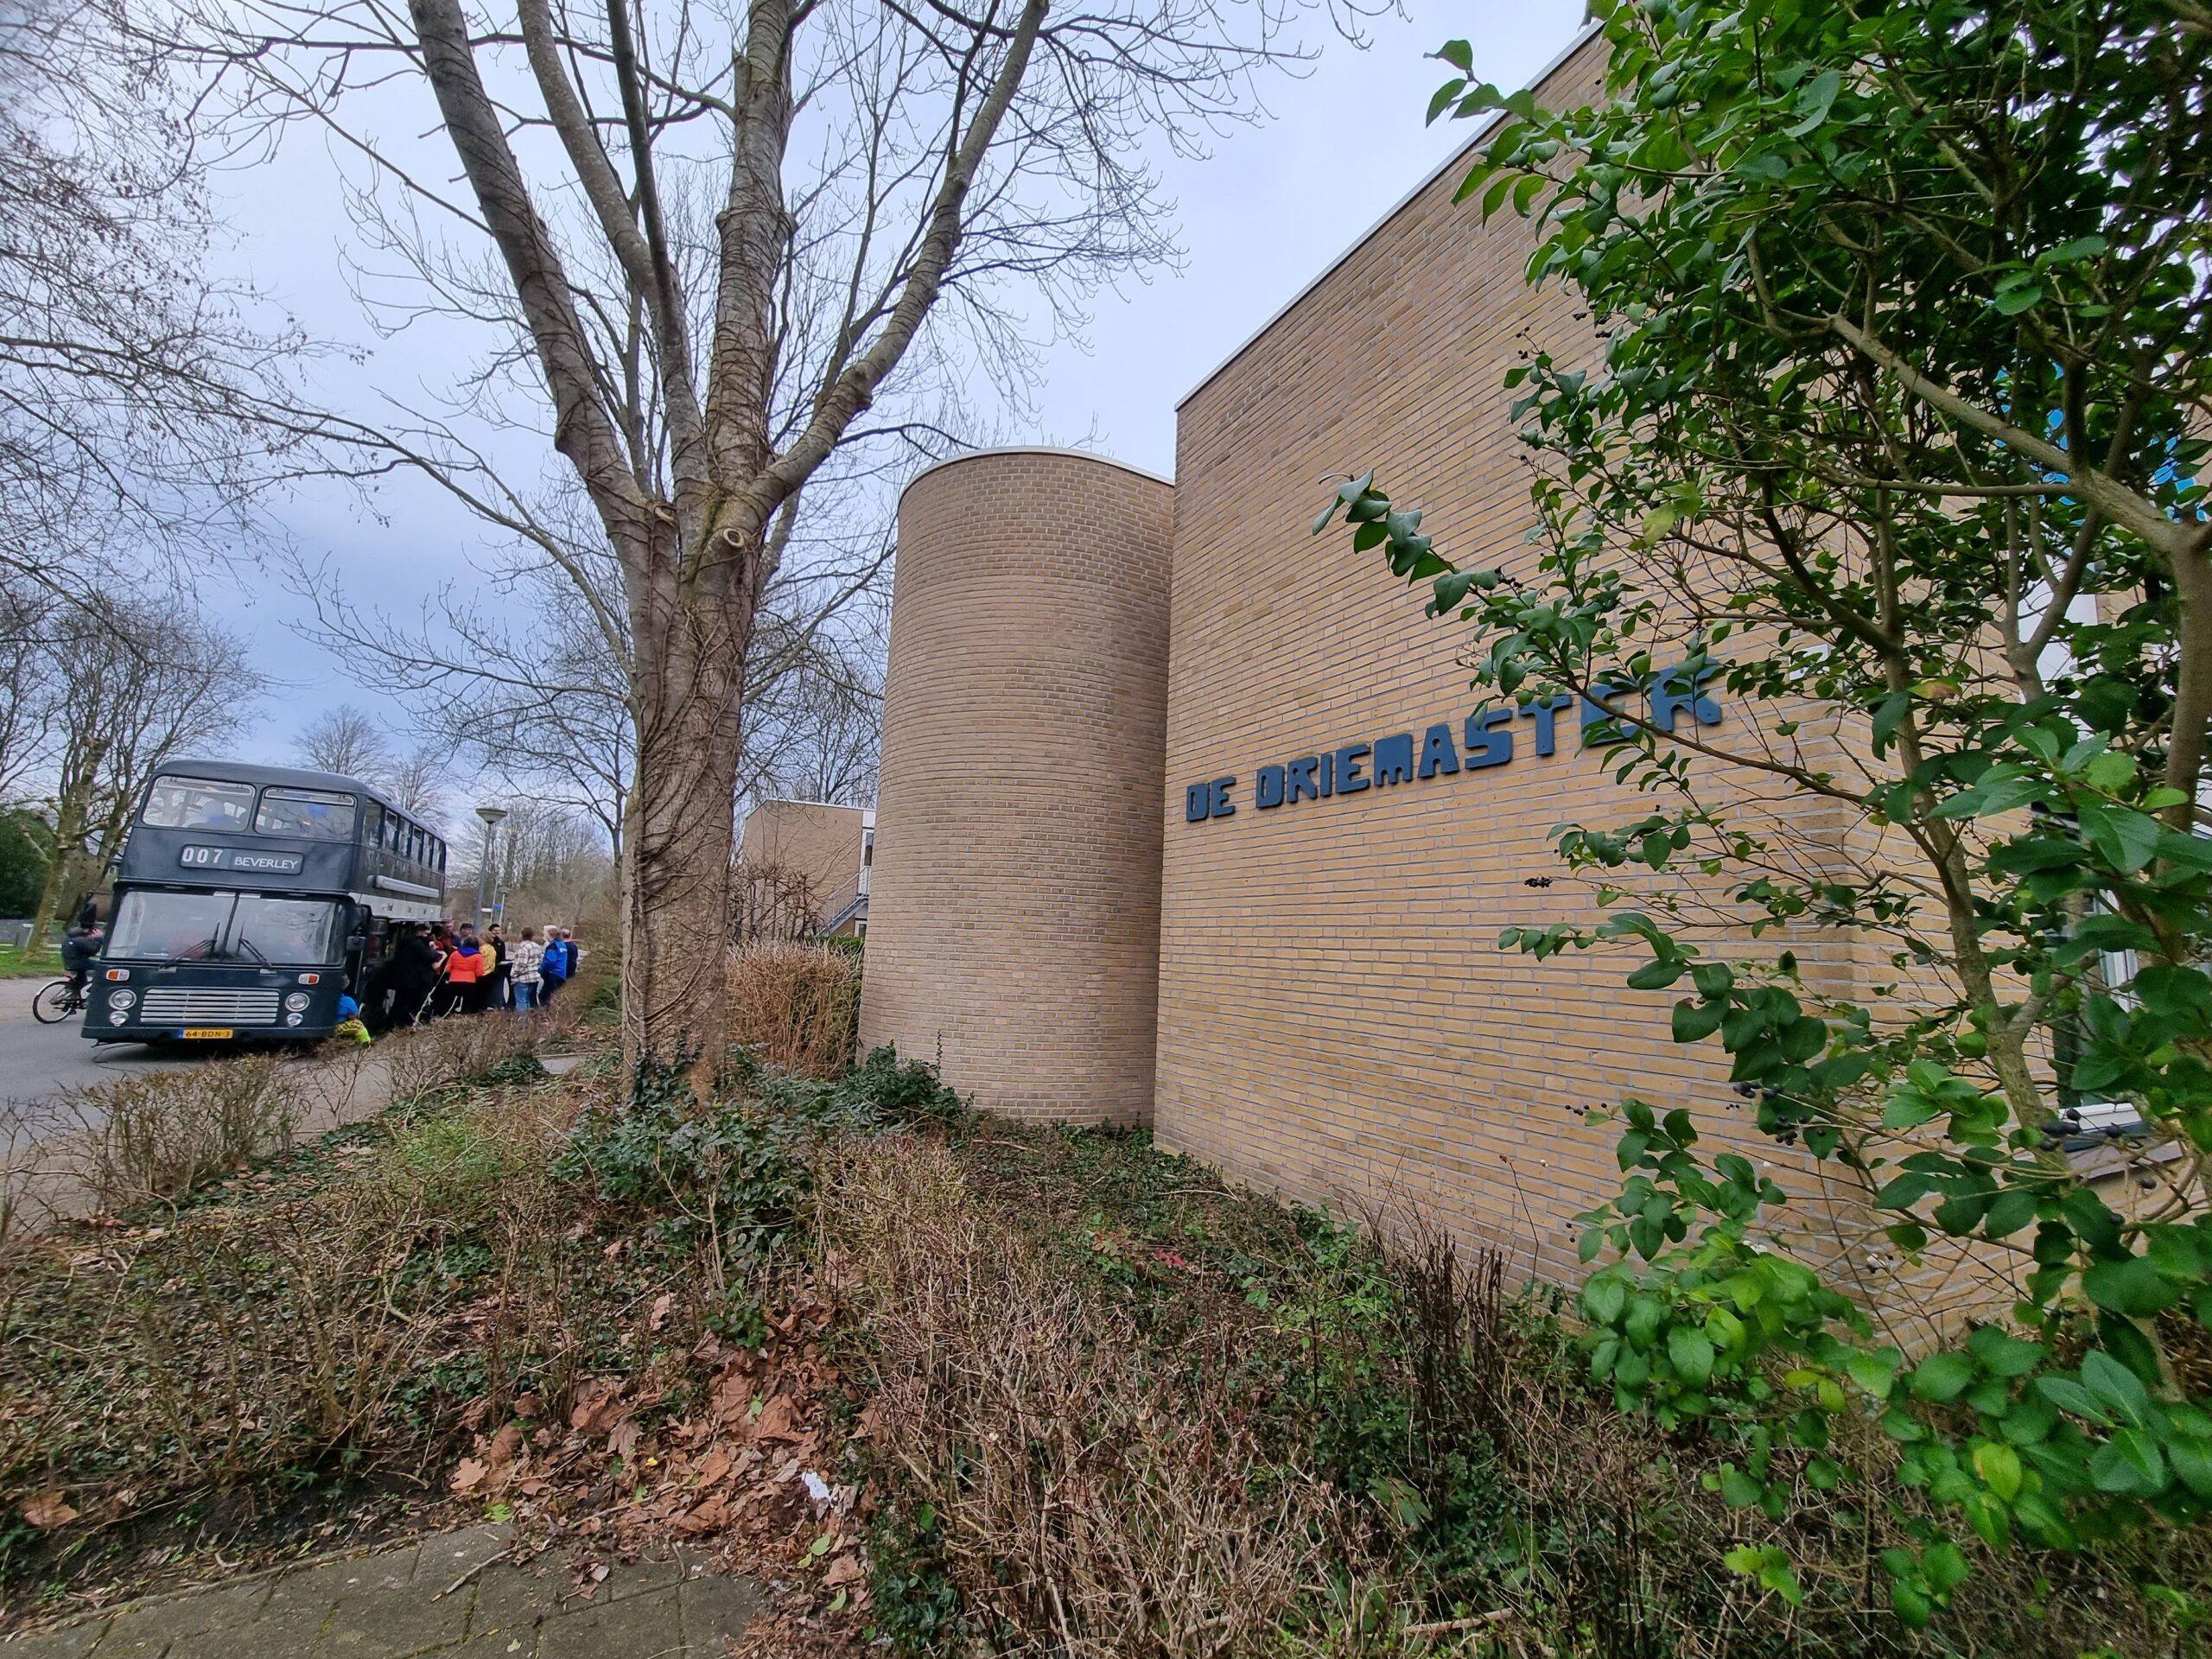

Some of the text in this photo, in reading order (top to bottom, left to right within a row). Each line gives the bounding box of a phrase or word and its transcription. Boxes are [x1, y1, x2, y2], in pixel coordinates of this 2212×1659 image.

[1186, 658, 1723, 822] DE DRIEMASTER
[181, 848, 298, 869] 007 BEVERLEY
